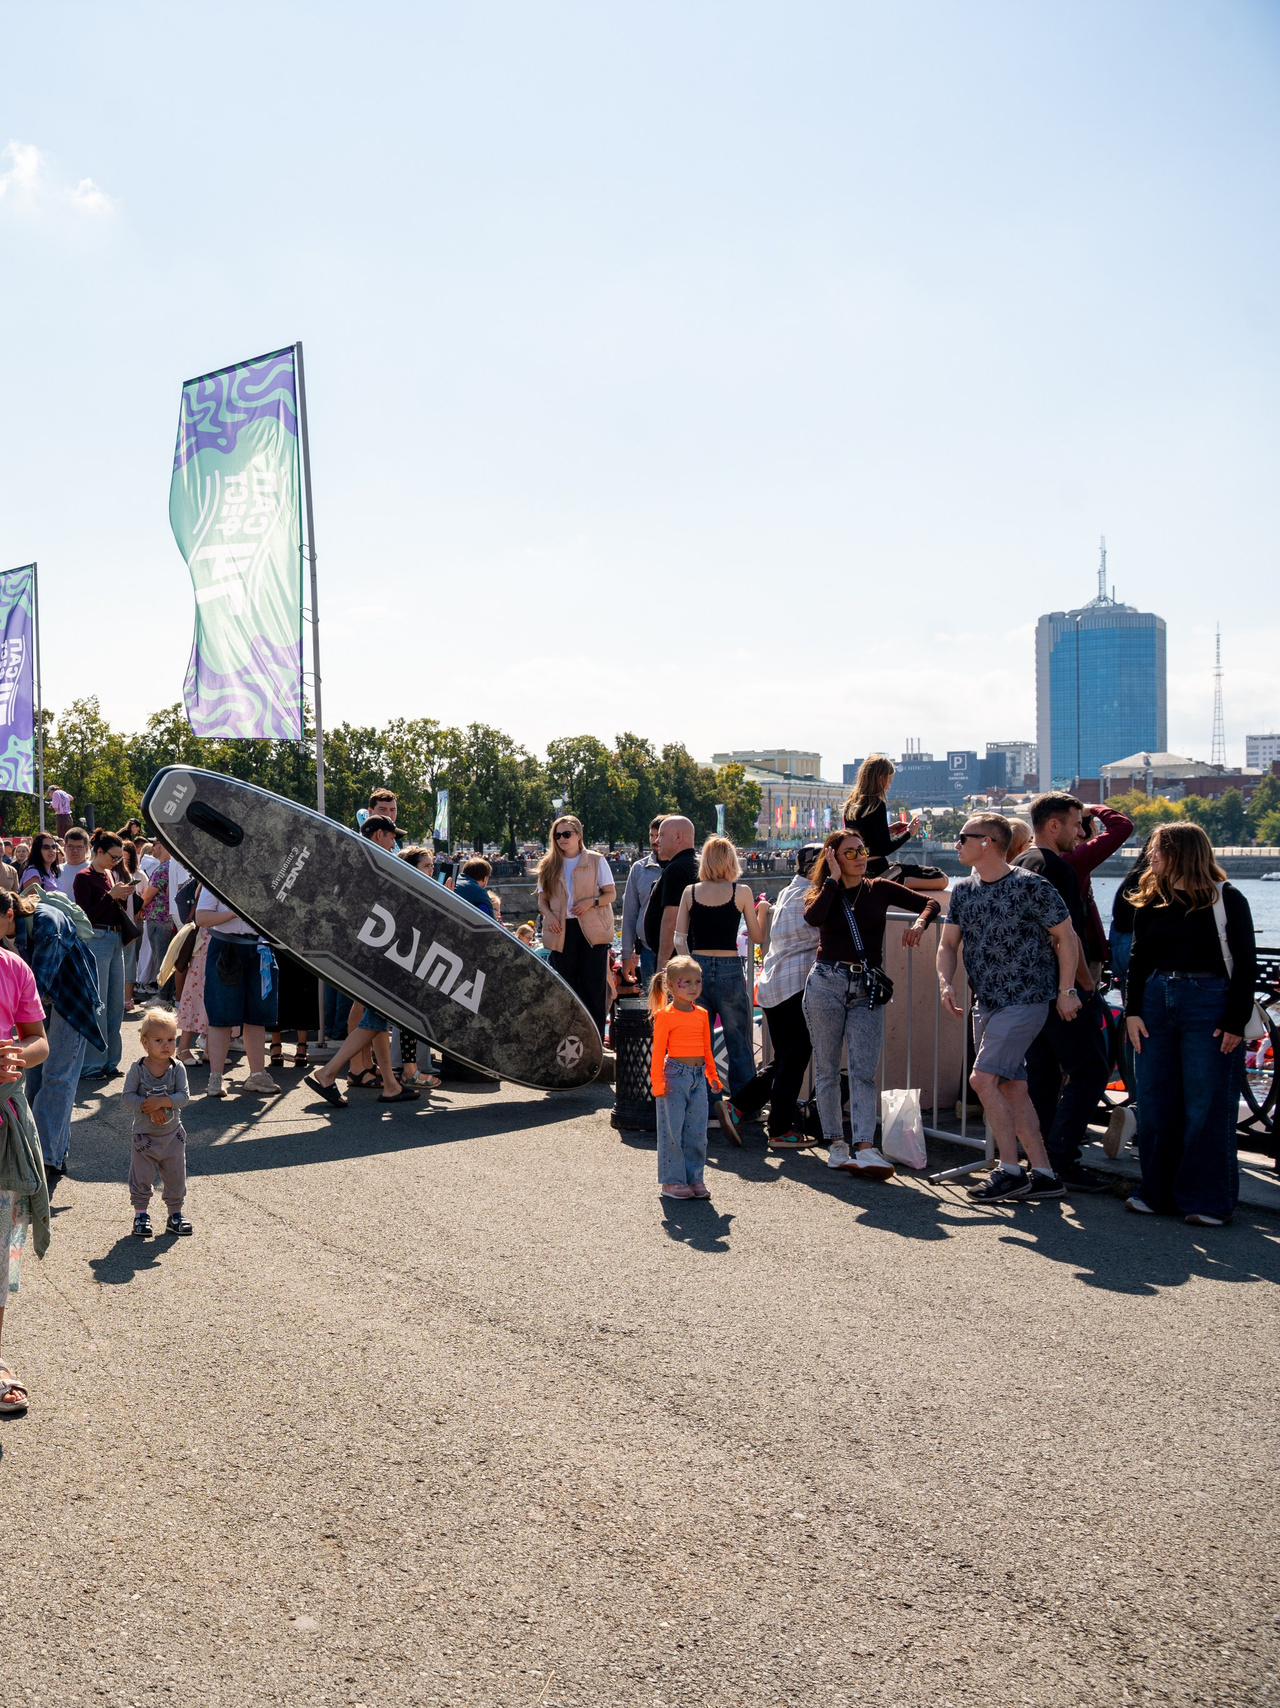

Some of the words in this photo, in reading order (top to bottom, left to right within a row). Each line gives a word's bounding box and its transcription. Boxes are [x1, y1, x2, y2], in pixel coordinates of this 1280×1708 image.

[953, 756, 963, 768] P
[275, 846, 311, 903] JUNGLE
[356, 903, 486, 1015] DAMA
